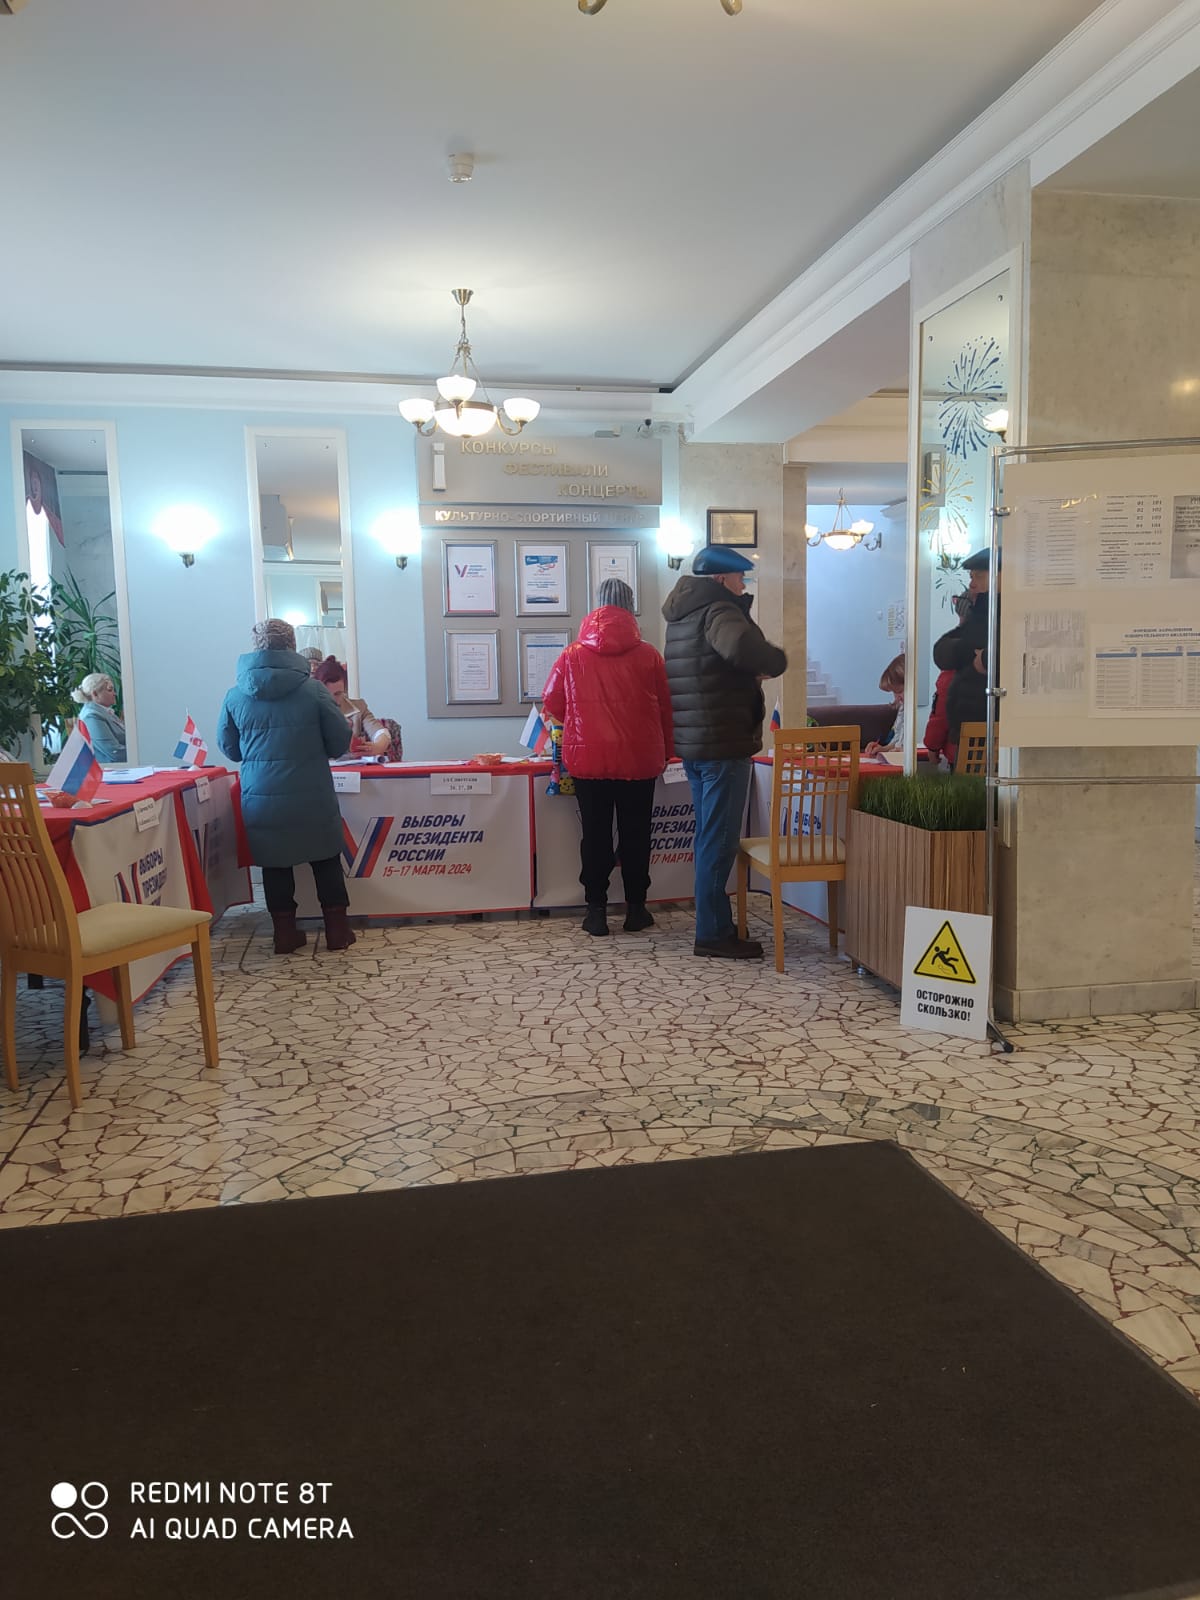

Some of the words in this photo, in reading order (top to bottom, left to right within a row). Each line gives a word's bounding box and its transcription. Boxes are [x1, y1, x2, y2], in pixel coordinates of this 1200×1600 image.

[461, 440, 557, 456] КОНКУРСЫ
[558, 483, 649, 500] КОНЦЕРТЫ
[400, 814, 466, 829] ВЫБОРЫ
[394, 830, 485, 846] ПРЕЗИДЕНТА
[650, 836, 693, 850] ОССИИ
[139, 848, 164, 876] ВЫБОРЫ
[387, 848, 446, 863] РОССИИ
[661, 851, 694, 864] МАРТА
[411, 863, 446, 877] МАРТА
[447, 862, 472, 876] 2024
[916, 989, 975, 1009] ОСТОРОЖНО
[917, 1003, 971, 1022] СКОЛЬЗКО!
